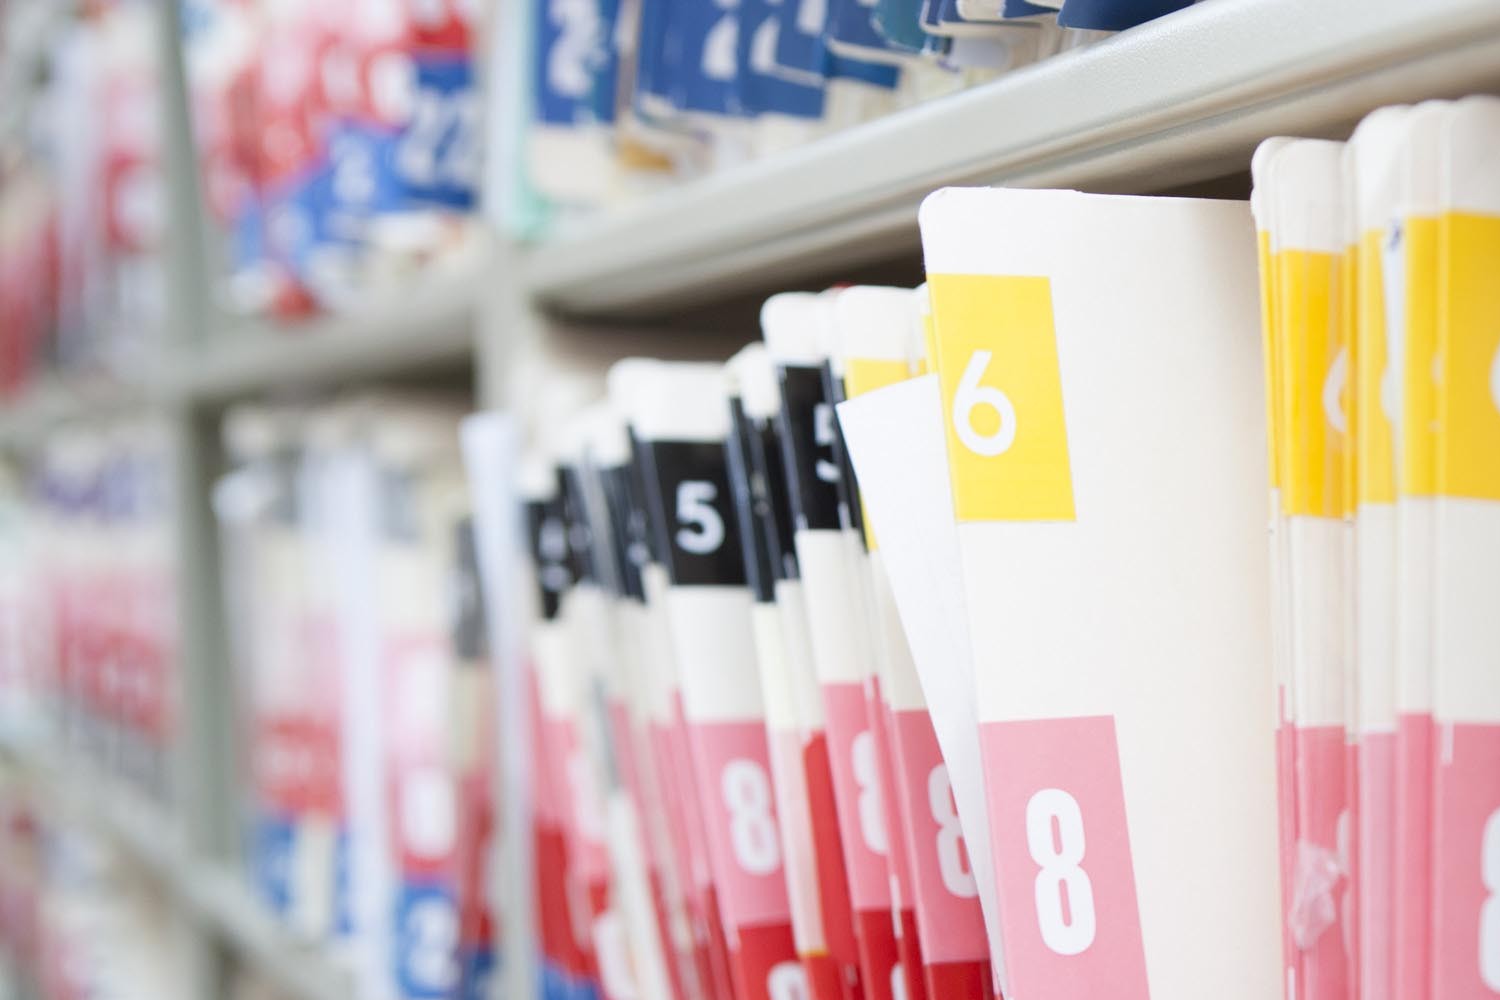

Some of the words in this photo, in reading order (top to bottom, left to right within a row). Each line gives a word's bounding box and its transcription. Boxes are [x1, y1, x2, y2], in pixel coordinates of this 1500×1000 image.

[676, 479, 726, 554] 5
[721, 758, 782, 874] 8
[953, 349, 1017, 456] 6
[1026, 788, 1096, 955] 8
